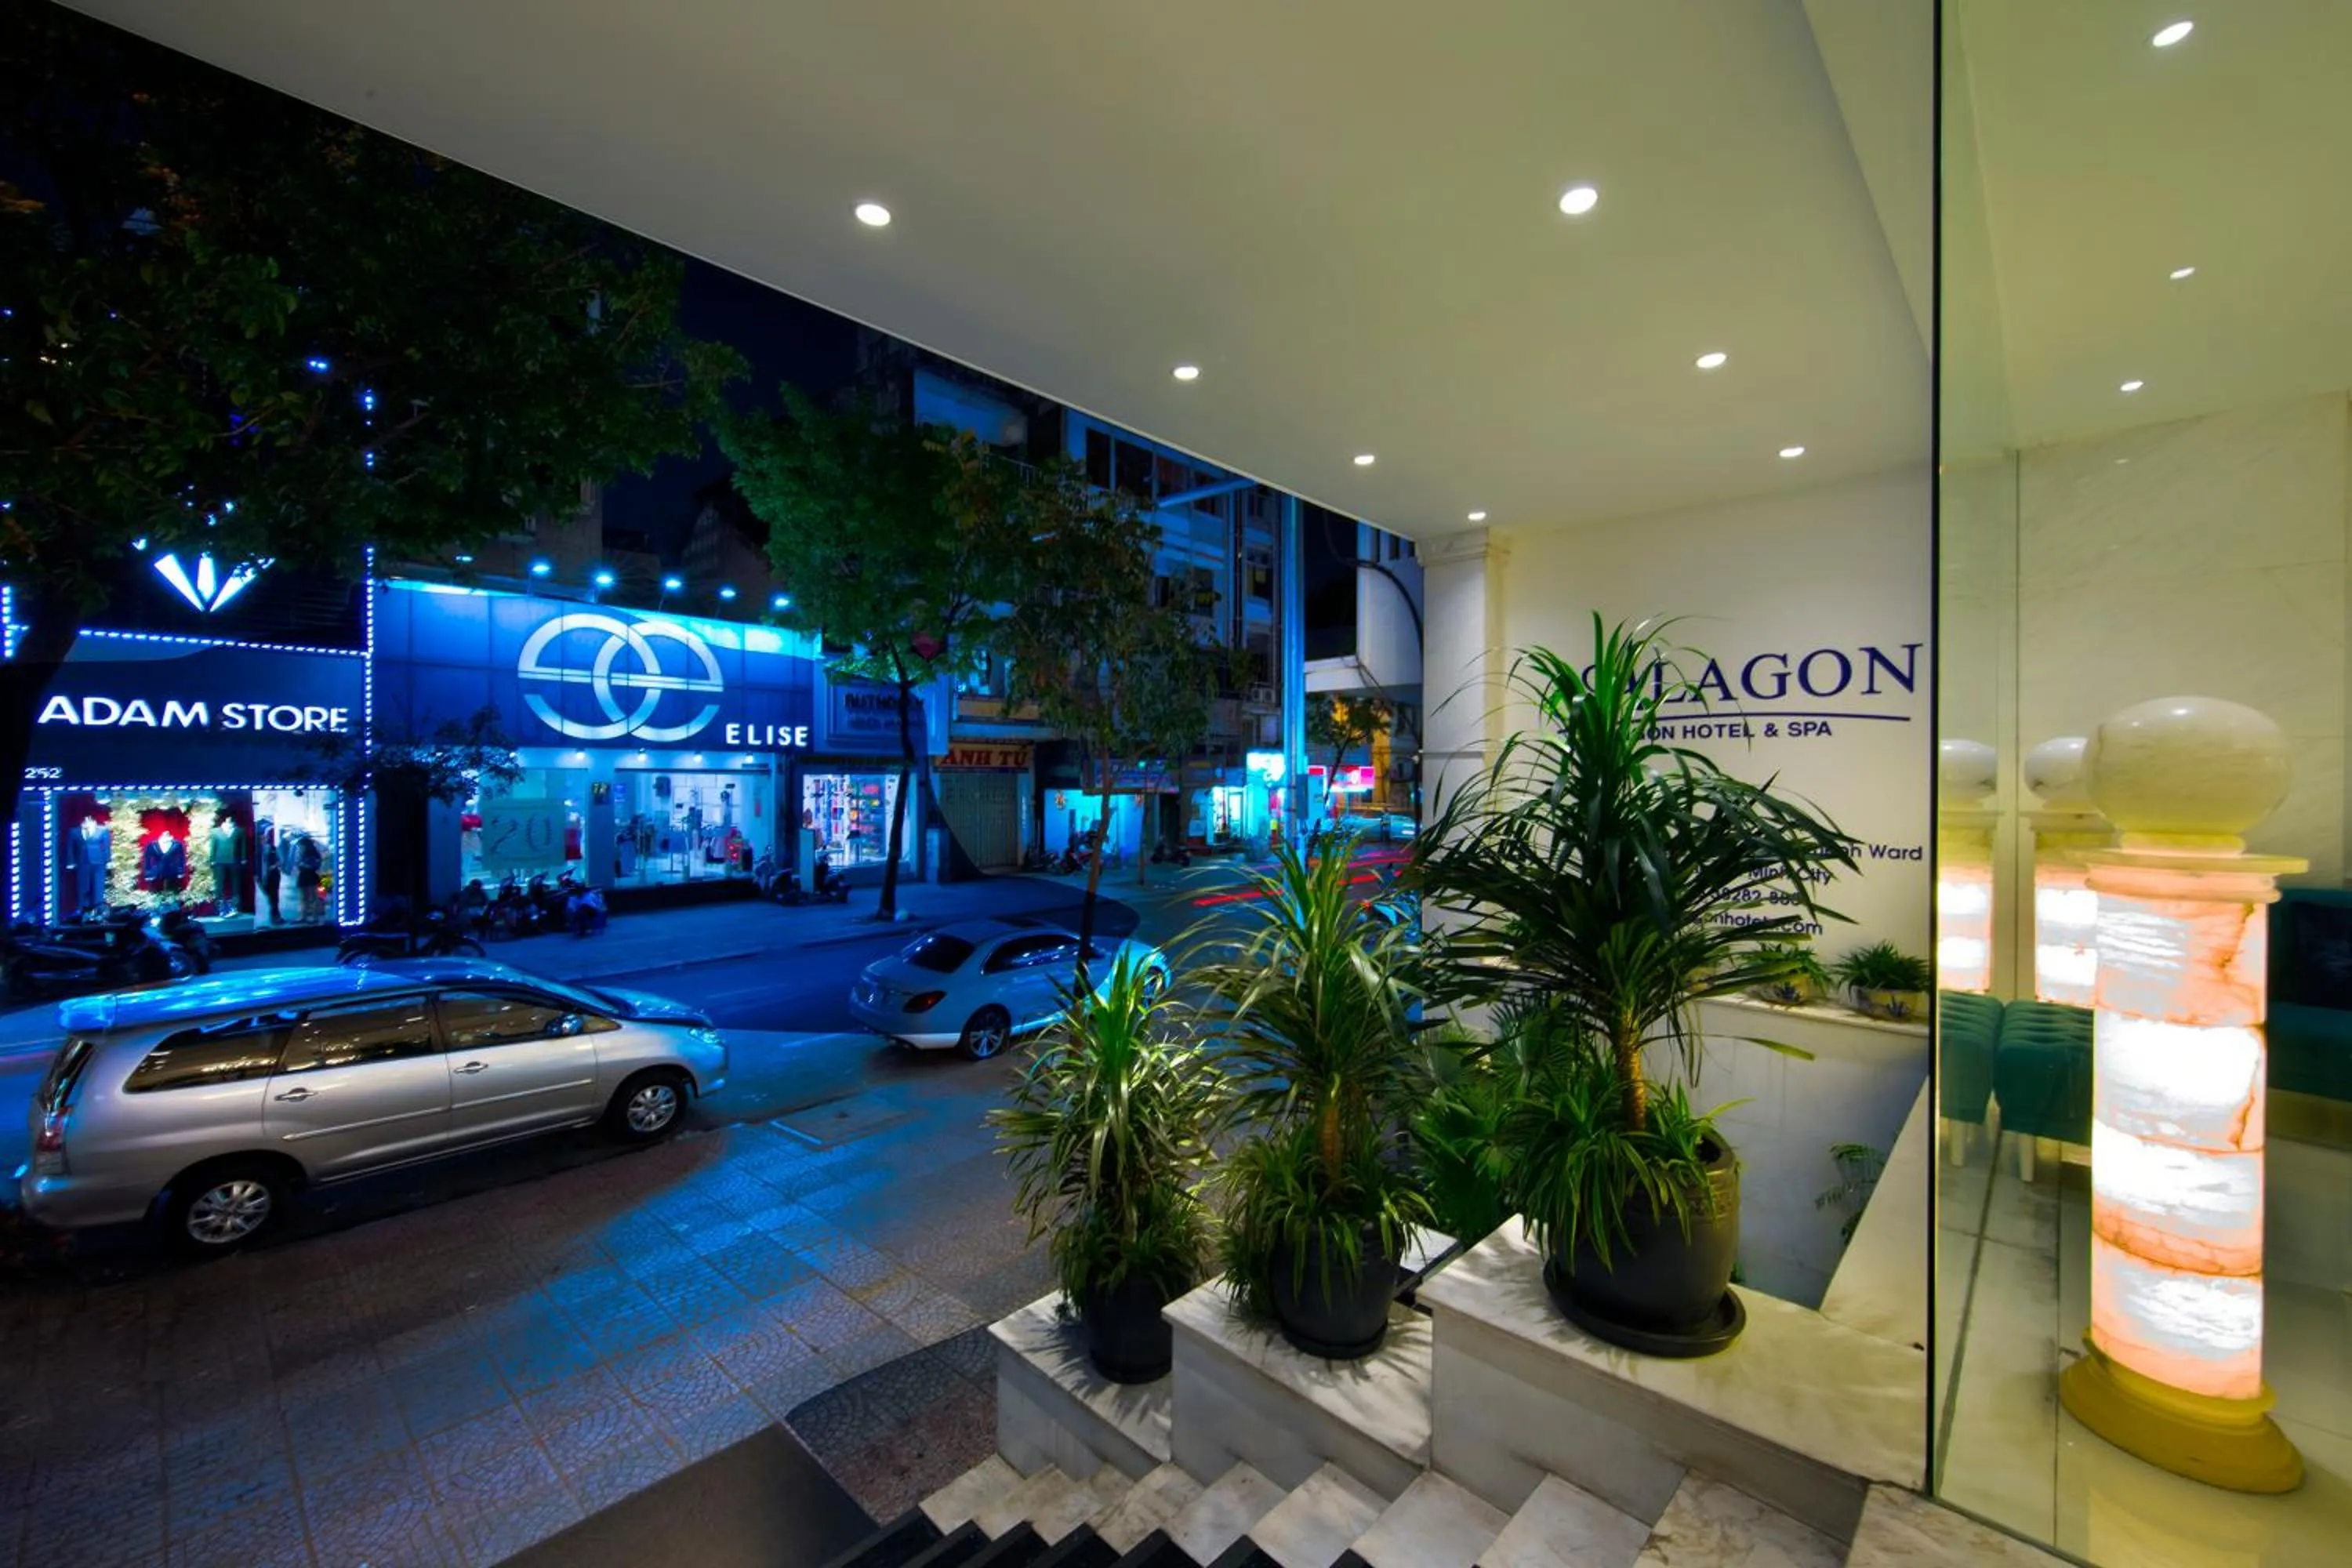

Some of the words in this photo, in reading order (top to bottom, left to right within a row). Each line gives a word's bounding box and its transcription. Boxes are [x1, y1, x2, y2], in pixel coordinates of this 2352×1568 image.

[37, 695, 209, 728] ADAM
[221, 702, 349, 733] STORE
[725, 723, 809, 747] ELISE
[1682, 722, 1755, 739] HOTEL
[1764, 722, 1779, 738] &
[1788, 720, 1832, 738] SPA
[24, 766, 63, 779] 252
[1868, 843, 1923, 862] Ward
[1797, 866, 1831, 885] City
